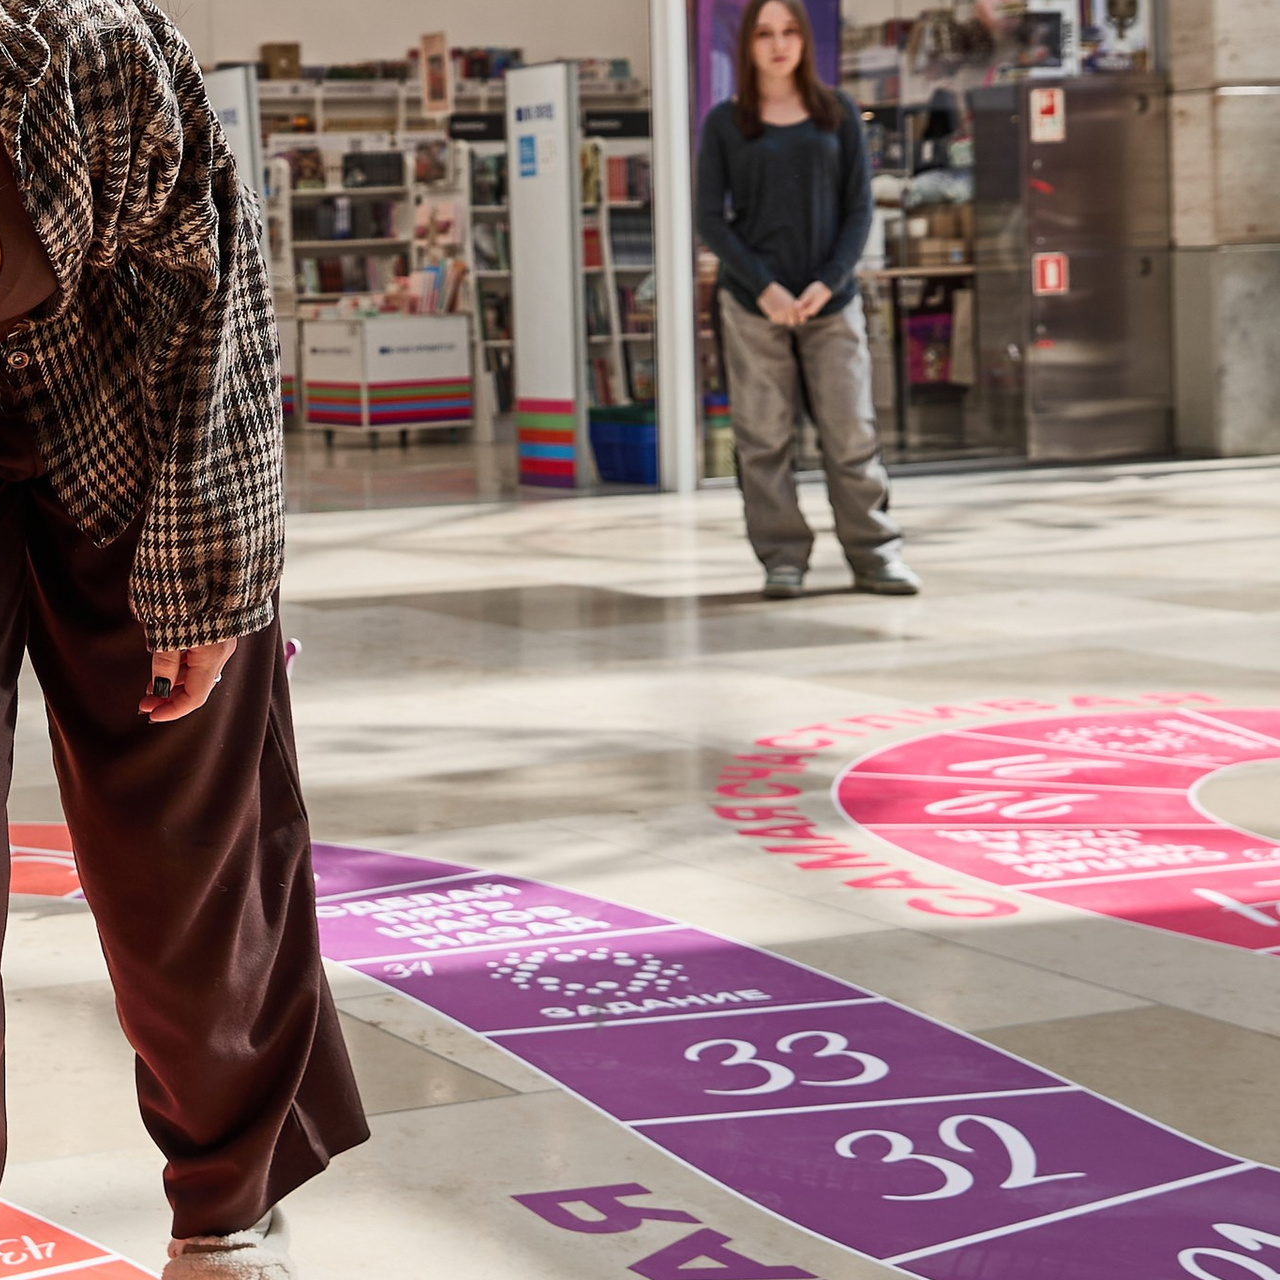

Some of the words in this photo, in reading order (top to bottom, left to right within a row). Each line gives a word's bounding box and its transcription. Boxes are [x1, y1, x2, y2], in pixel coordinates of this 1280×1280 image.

[715, 691, 1222, 800] СЧАСТЛИВАЯ
[924, 789, 1100, 820] 22
[712, 805, 1020, 919] САМАЯ
[316, 882, 522, 919] СДЕЛАЙ
[371, 899, 514, 925] ПЯТЬ
[375, 905, 571, 939] ШАГОВ
[410, 915, 612, 949] НАЗАД
[540, 988, 772, 1019] ЗАДАНИЕ
[684, 1029, 890, 1096] 33
[834, 1113, 1088, 1202] 32
